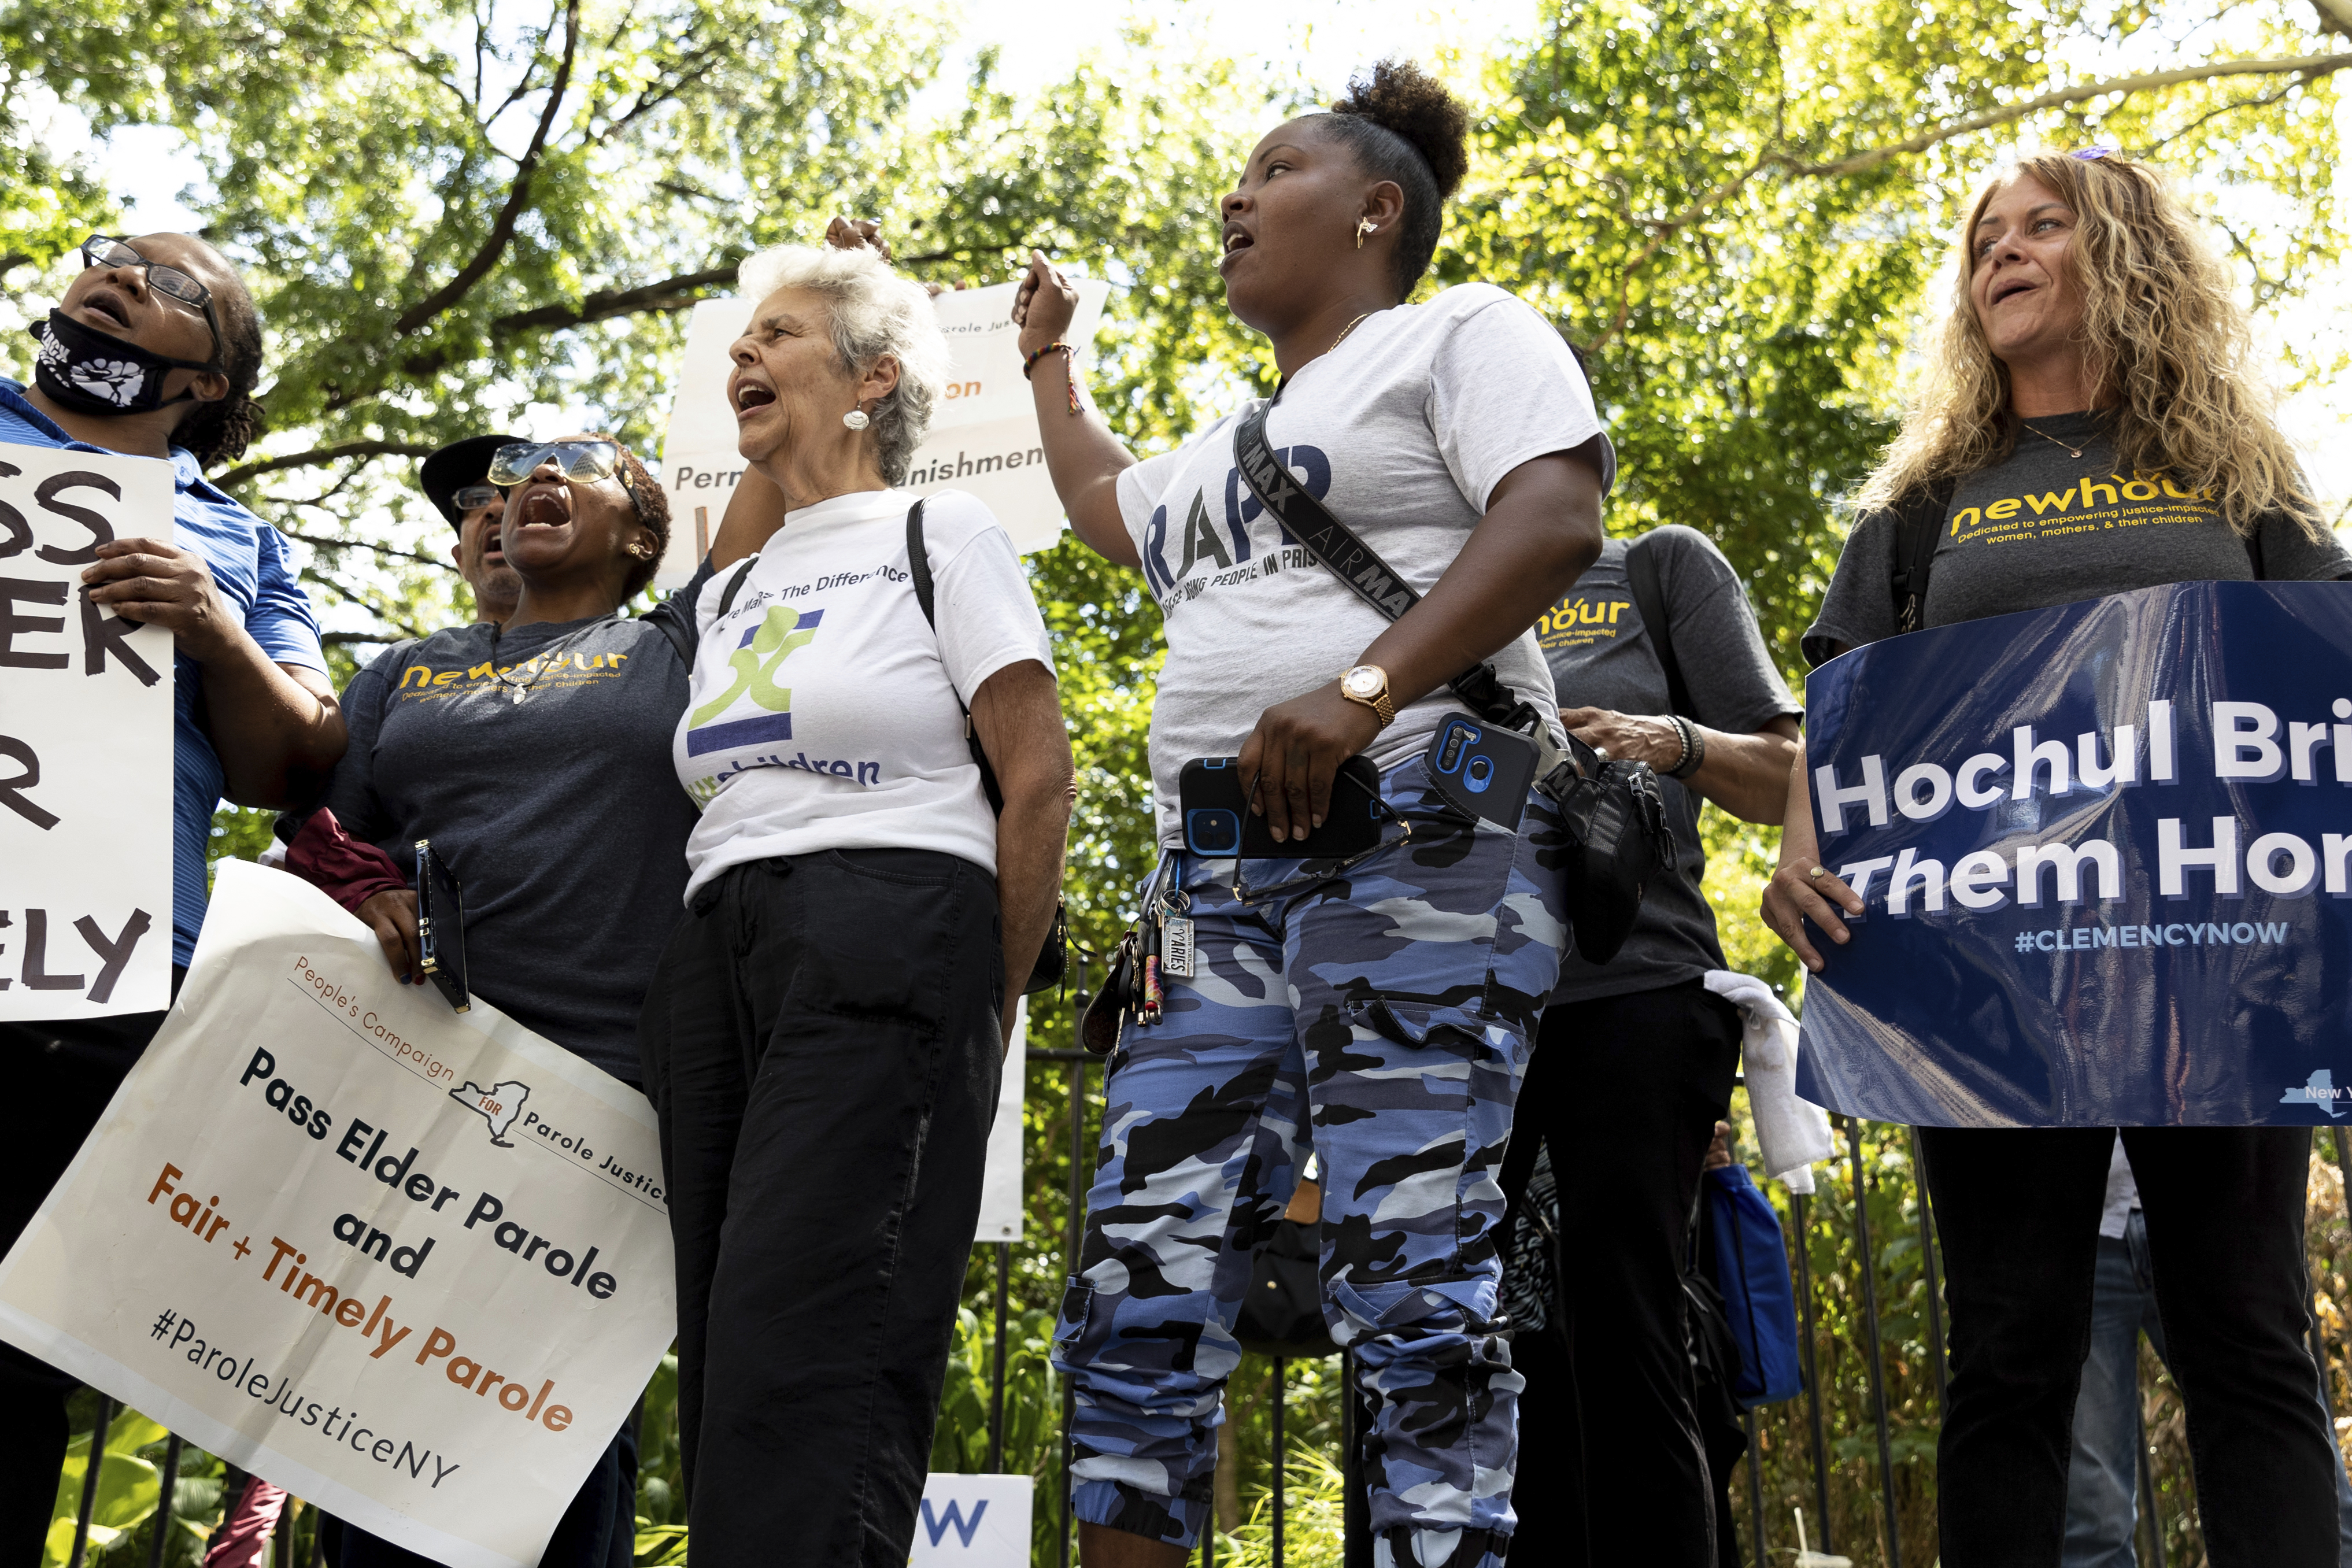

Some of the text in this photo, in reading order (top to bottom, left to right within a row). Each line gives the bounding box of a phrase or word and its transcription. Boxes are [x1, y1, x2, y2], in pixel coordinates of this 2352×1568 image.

[988, 320, 1015, 332] Jus
[944, 381, 981, 400] on
[896, 448, 1042, 487] nishmen
[1958, 522, 2018, 543] Dedicated
[2039, 509, 2118, 526] empowering
[2122, 504, 2220, 517] justice-impacted
[1987, 515, 2202, 544] women, mothers, & their children
[782, 584, 811, 601] The
[1184, 576, 1208, 602] AGING
[1211, 561, 1258, 587] PEOPLE
[1263, 553, 1278, 576] IN
[1282, 549, 1317, 570] PRIS
[0, 577, 162, 687] ER
[538, 671, 622, 682] ustice-impacted
[718, 752, 881, 786] cdren
[1815, 698, 2173, 834] Hochul
[1838, 838, 2120, 919] Them
[0, 907, 152, 1004] LY
[1171, 940, 1186, 971] ARIES
[2015, 922, 2288, 953] #CLEMENCYNOW
[295, 956, 455, 1082] People's Campaign
[2305, 1086, 2341, 1099] New
[478, 1094, 502, 1116] FOR
[523, 1112, 593, 1160] Parole
[239, 1046, 617, 1300] Pass Elder Parole
[333, 1212, 436, 1279] and
[147, 1162, 231, 1243] Fair
[262, 1237, 412, 1359] Timely
[415, 1326, 574, 1433] Parole
[150, 1308, 460, 1490] #ParoleJusticeNY
